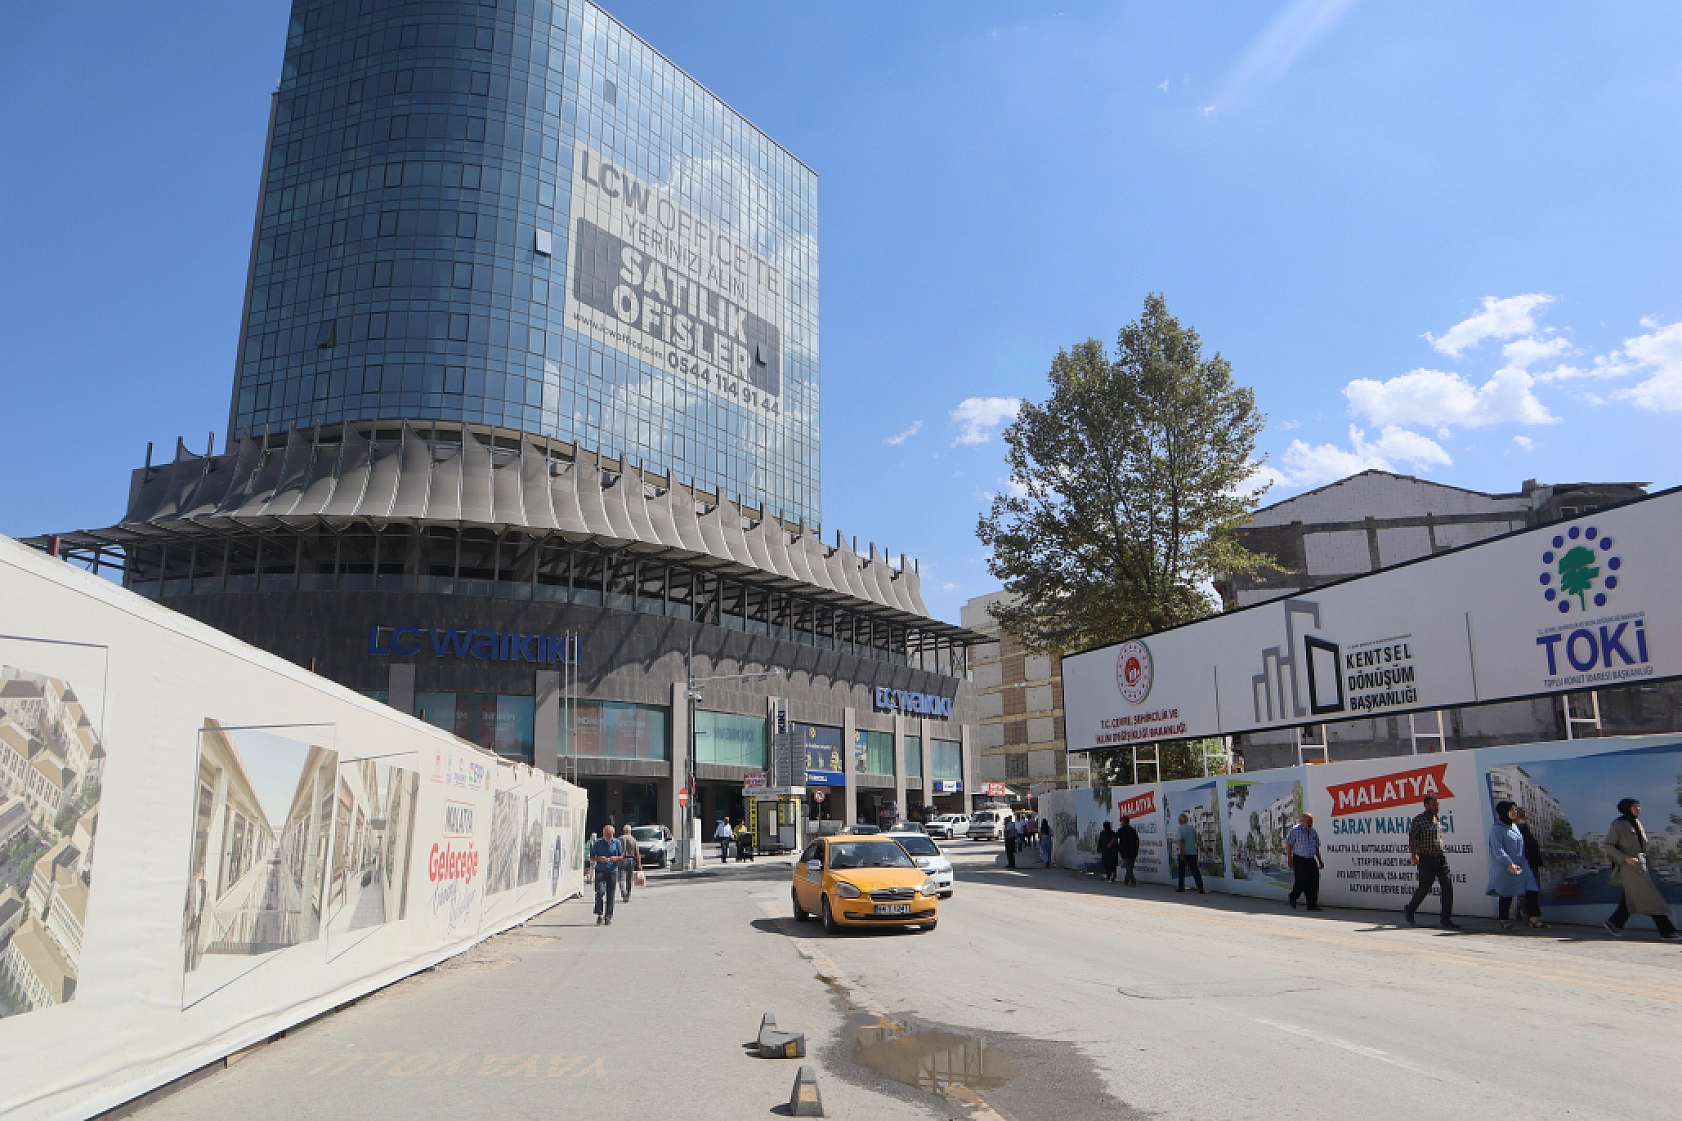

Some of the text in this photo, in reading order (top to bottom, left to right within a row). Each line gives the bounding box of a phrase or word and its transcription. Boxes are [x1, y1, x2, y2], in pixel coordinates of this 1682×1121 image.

[581, 149, 652, 216] LCW
[619, 246, 749, 345] SATILIK
[612, 284, 753, 383] OFİSLER
[667, 350, 712, 385] 0544
[715, 372, 738, 398] 114
[741, 381, 758, 408] 91
[761, 395, 781, 419] 44
[368, 624, 421, 657] LC
[1345, 643, 1412, 669] KENTSEL
[1347, 663, 1415, 691] DÖNÜŞÜM
[876, 685, 898, 709] LC
[1349, 685, 1418, 713] BAŞKANLIĞI
[1338, 774, 1439, 809] MALATYA
[1332, 816, 1372, 835] SARAY
